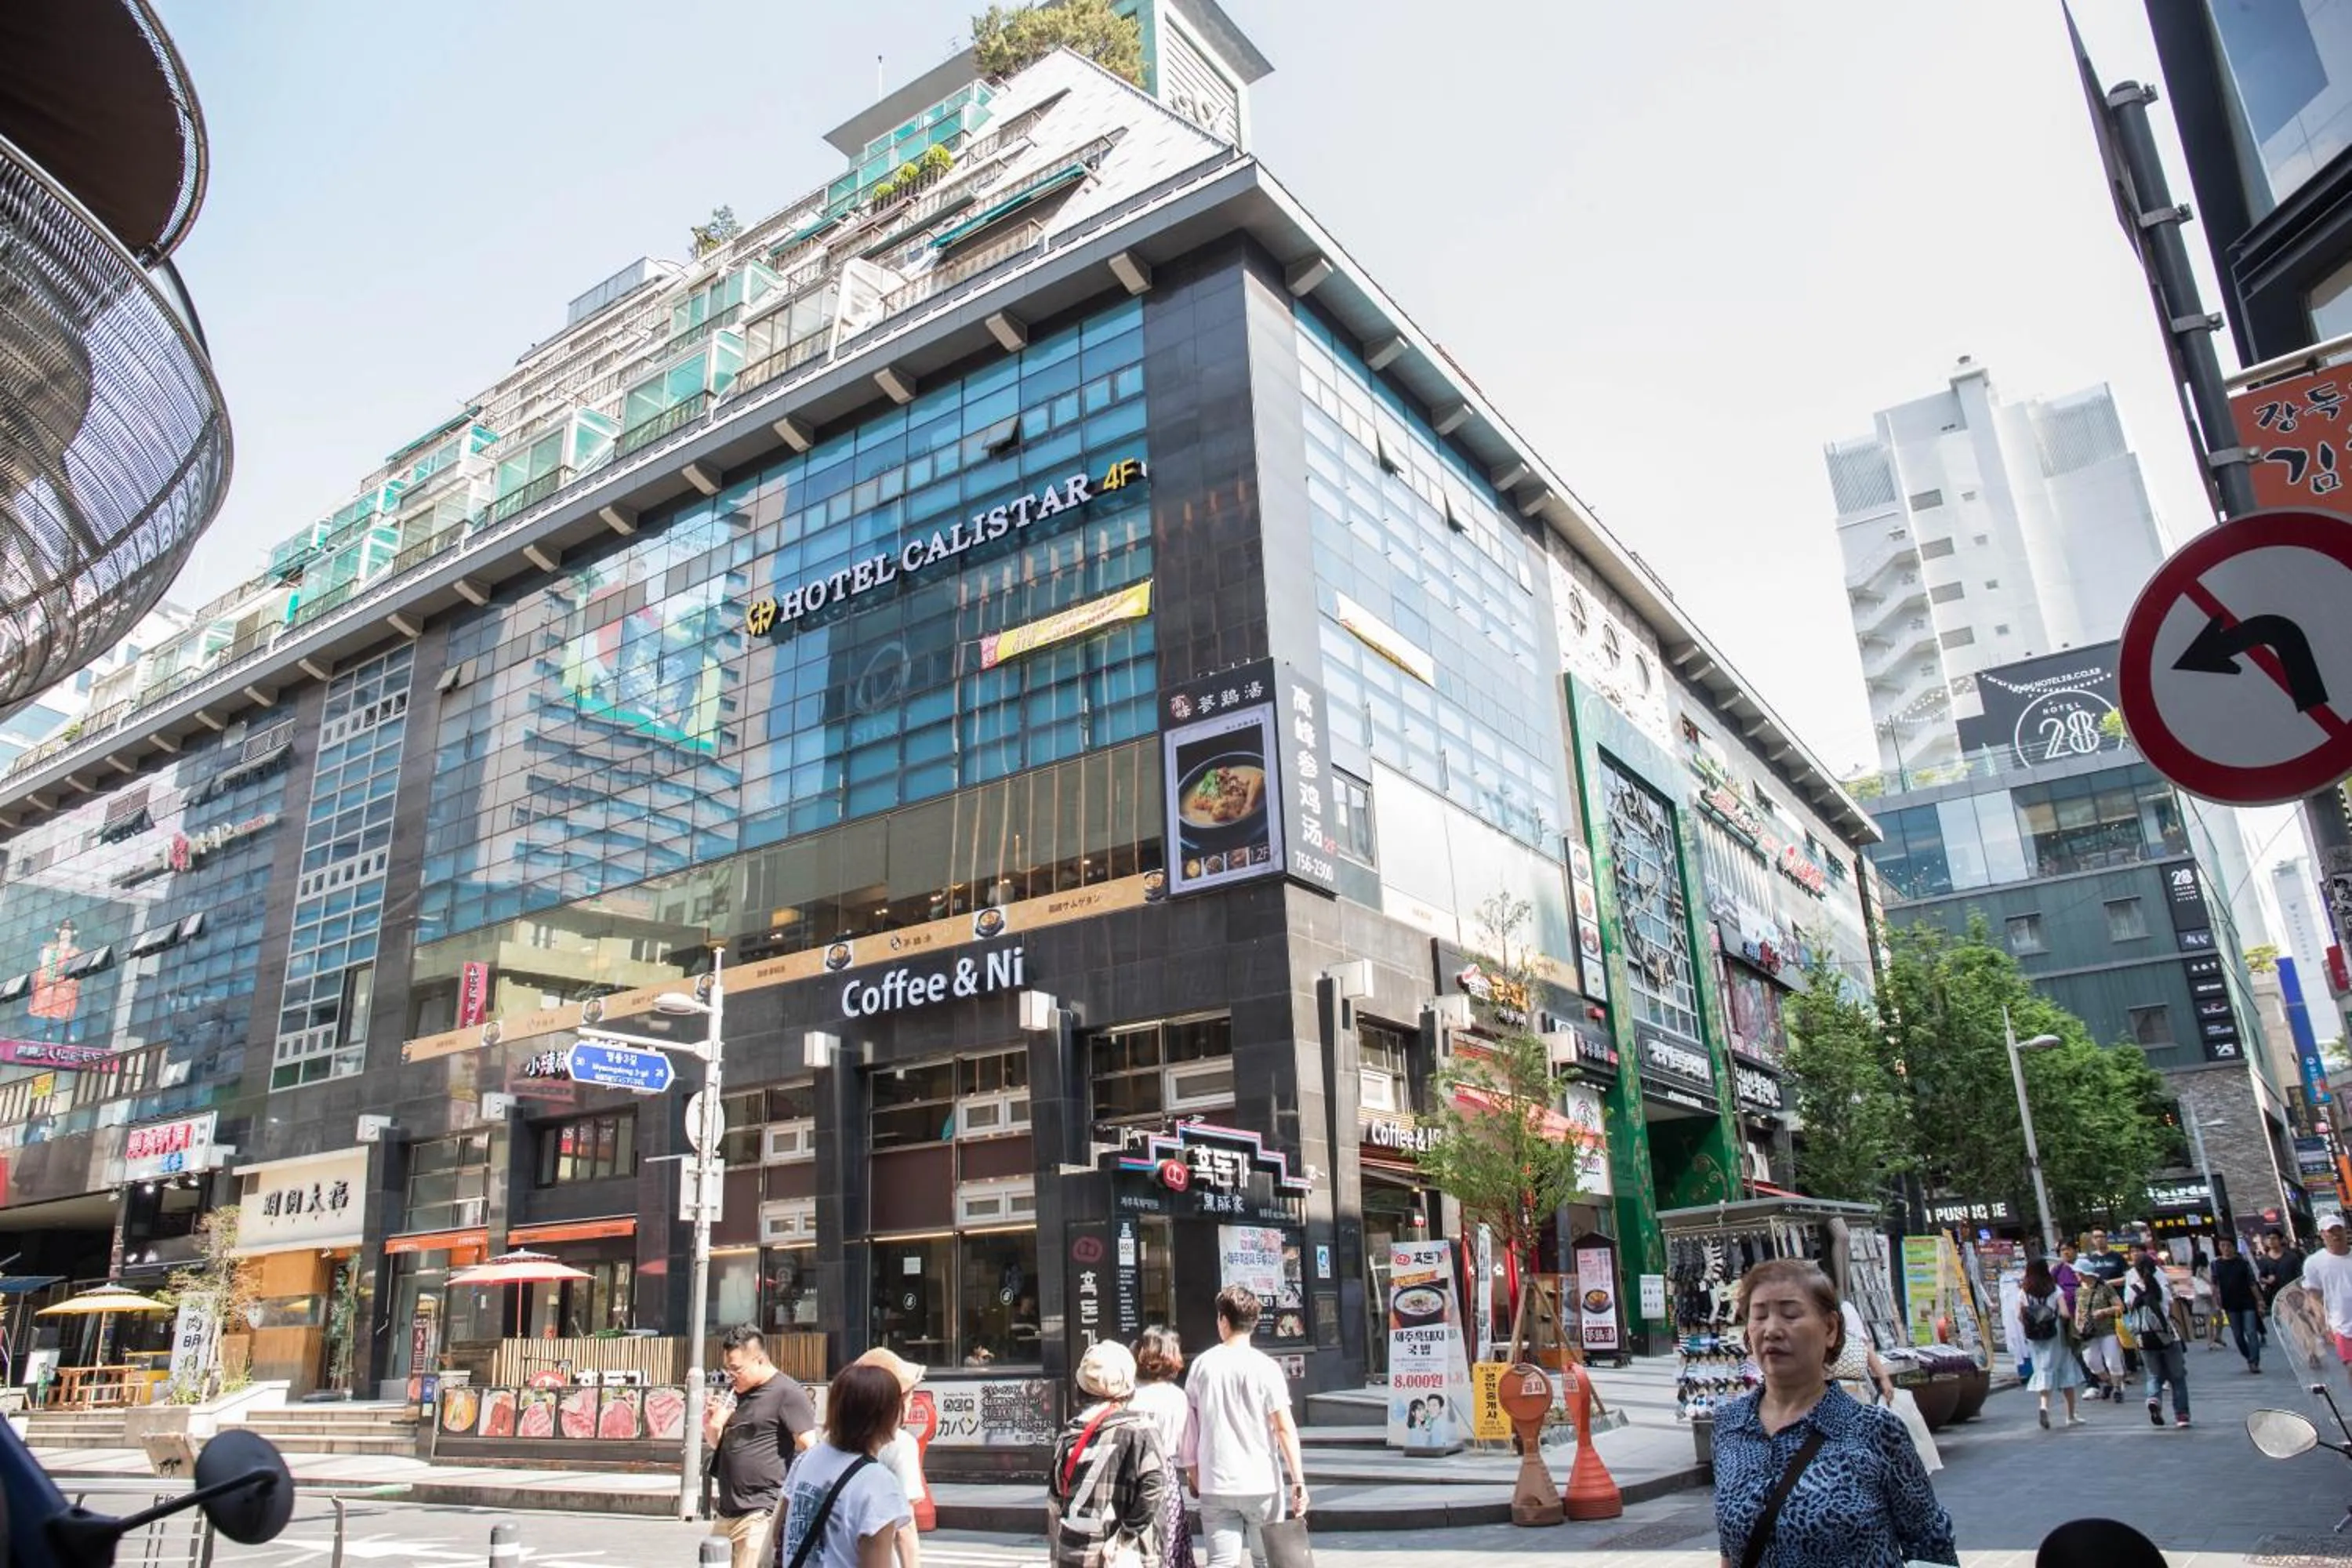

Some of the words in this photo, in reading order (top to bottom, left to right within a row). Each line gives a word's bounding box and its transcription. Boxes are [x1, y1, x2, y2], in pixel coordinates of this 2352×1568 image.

[2254, 382, 2352, 432] 장독
[2264, 437, 2352, 494] 김
[781, 554, 896, 623] HOTEL
[902, 474, 1092, 572] CALISTAR
[1103, 459, 1135, 492] 4F
[2039, 710, 2100, 759] 28
[2171, 869, 2194, 885] 28
[842, 967, 947, 1018] Coffee
[954, 957, 978, 997] &
[987, 947, 1025, 989] Ni
[1372, 1120, 1414, 1149] Coffee
[1417, 1127, 1426, 1152] &
[1195, 1145, 1250, 1188] 흑돈가
[1080, 1270, 1098, 1347] 흑돈가
[1393, 1374, 1444, 1389] 8,000원
